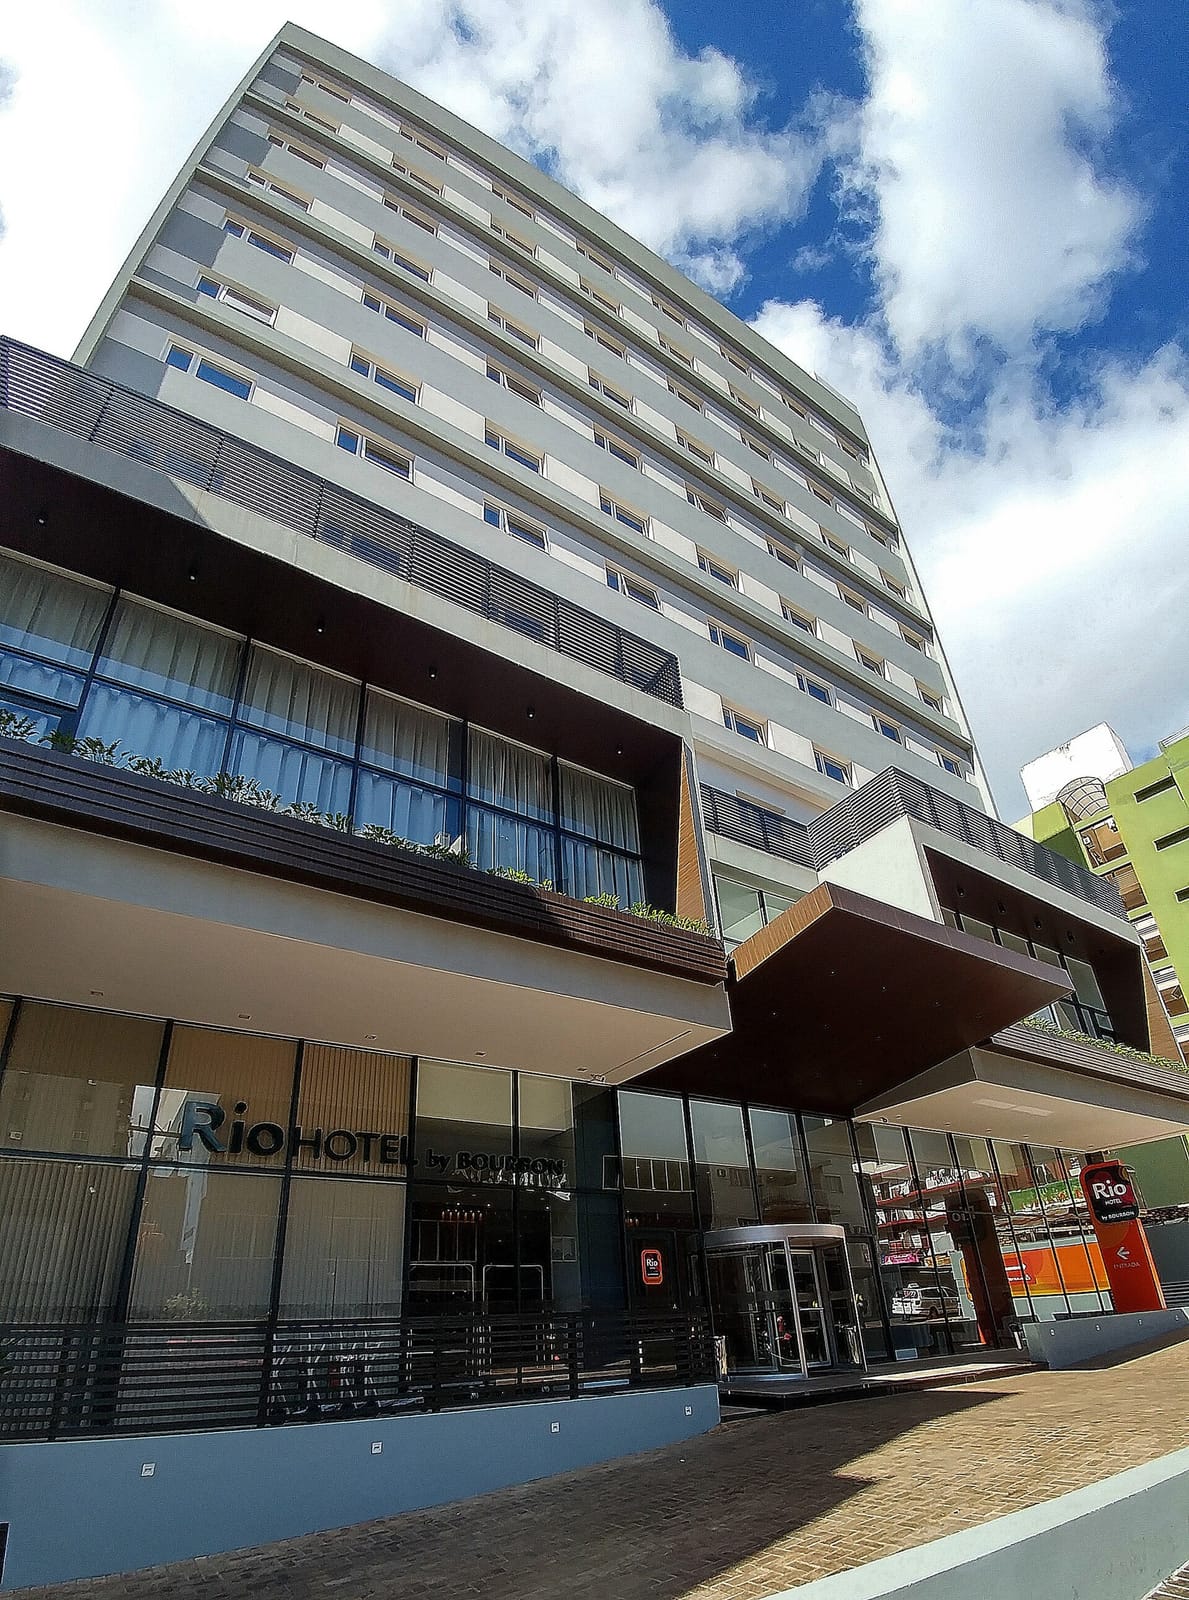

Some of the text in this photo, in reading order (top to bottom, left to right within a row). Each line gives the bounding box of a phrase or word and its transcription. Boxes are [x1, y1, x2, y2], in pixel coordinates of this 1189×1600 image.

[179, 1101, 568, 1175] Rio HOTEL by BOURBON
[1092, 1179, 1127, 1200] Rio
[1105, 1198, 1122, 1206] HOTEL
[647, 1258, 658, 1267] Rio
